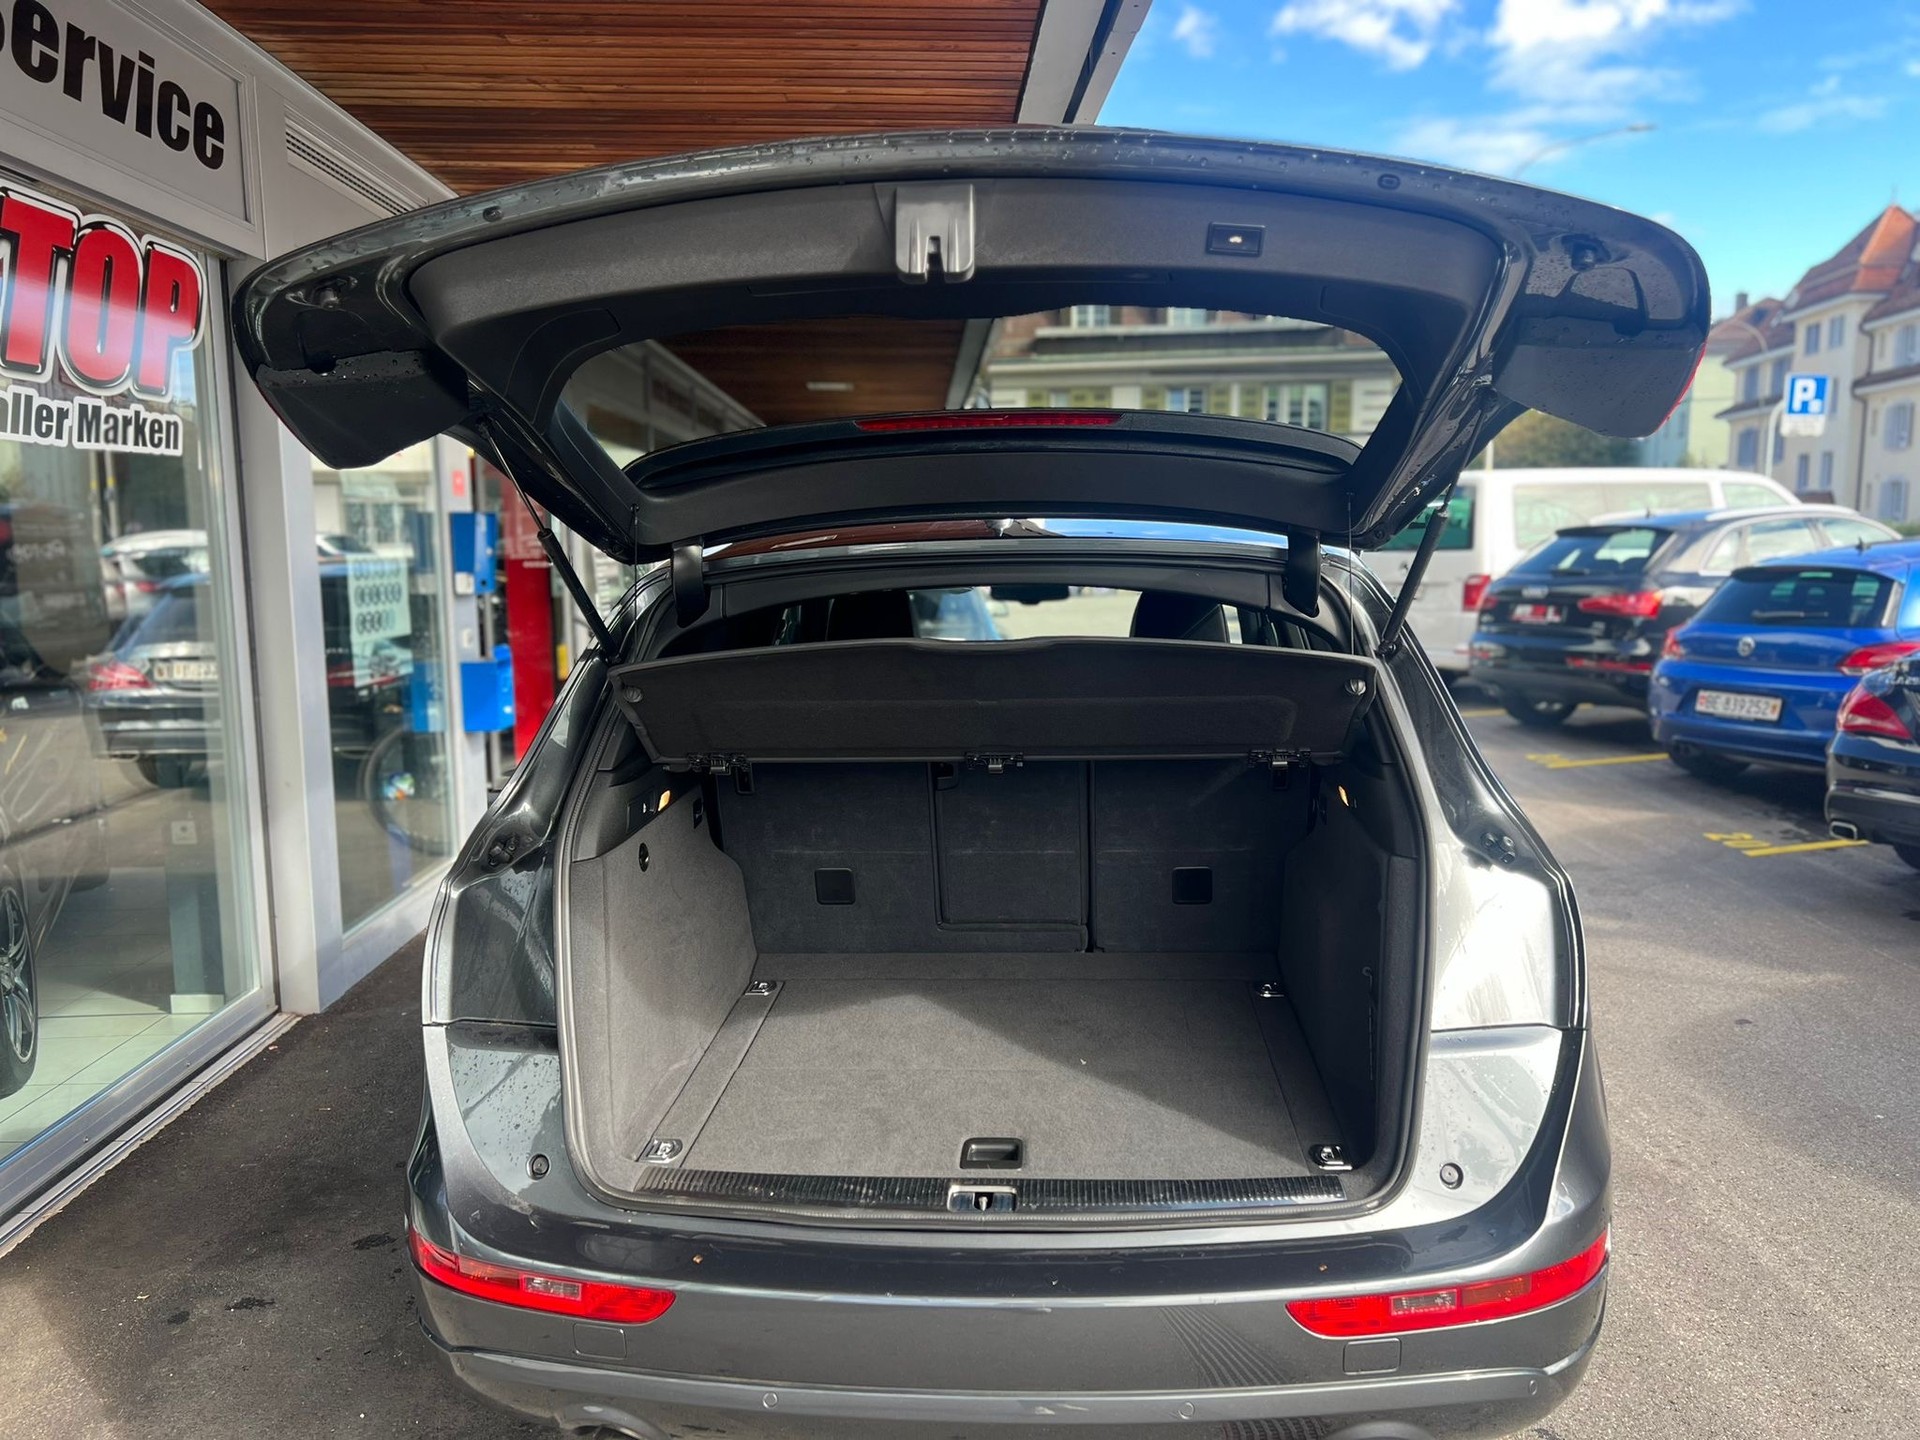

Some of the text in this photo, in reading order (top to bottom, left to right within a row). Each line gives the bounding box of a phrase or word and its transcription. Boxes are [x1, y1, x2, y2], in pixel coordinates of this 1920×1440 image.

[0, 0, 225, 170] ervice
[0, 187, 204, 395] TOP
[77, 402, 180, 451] Marken
